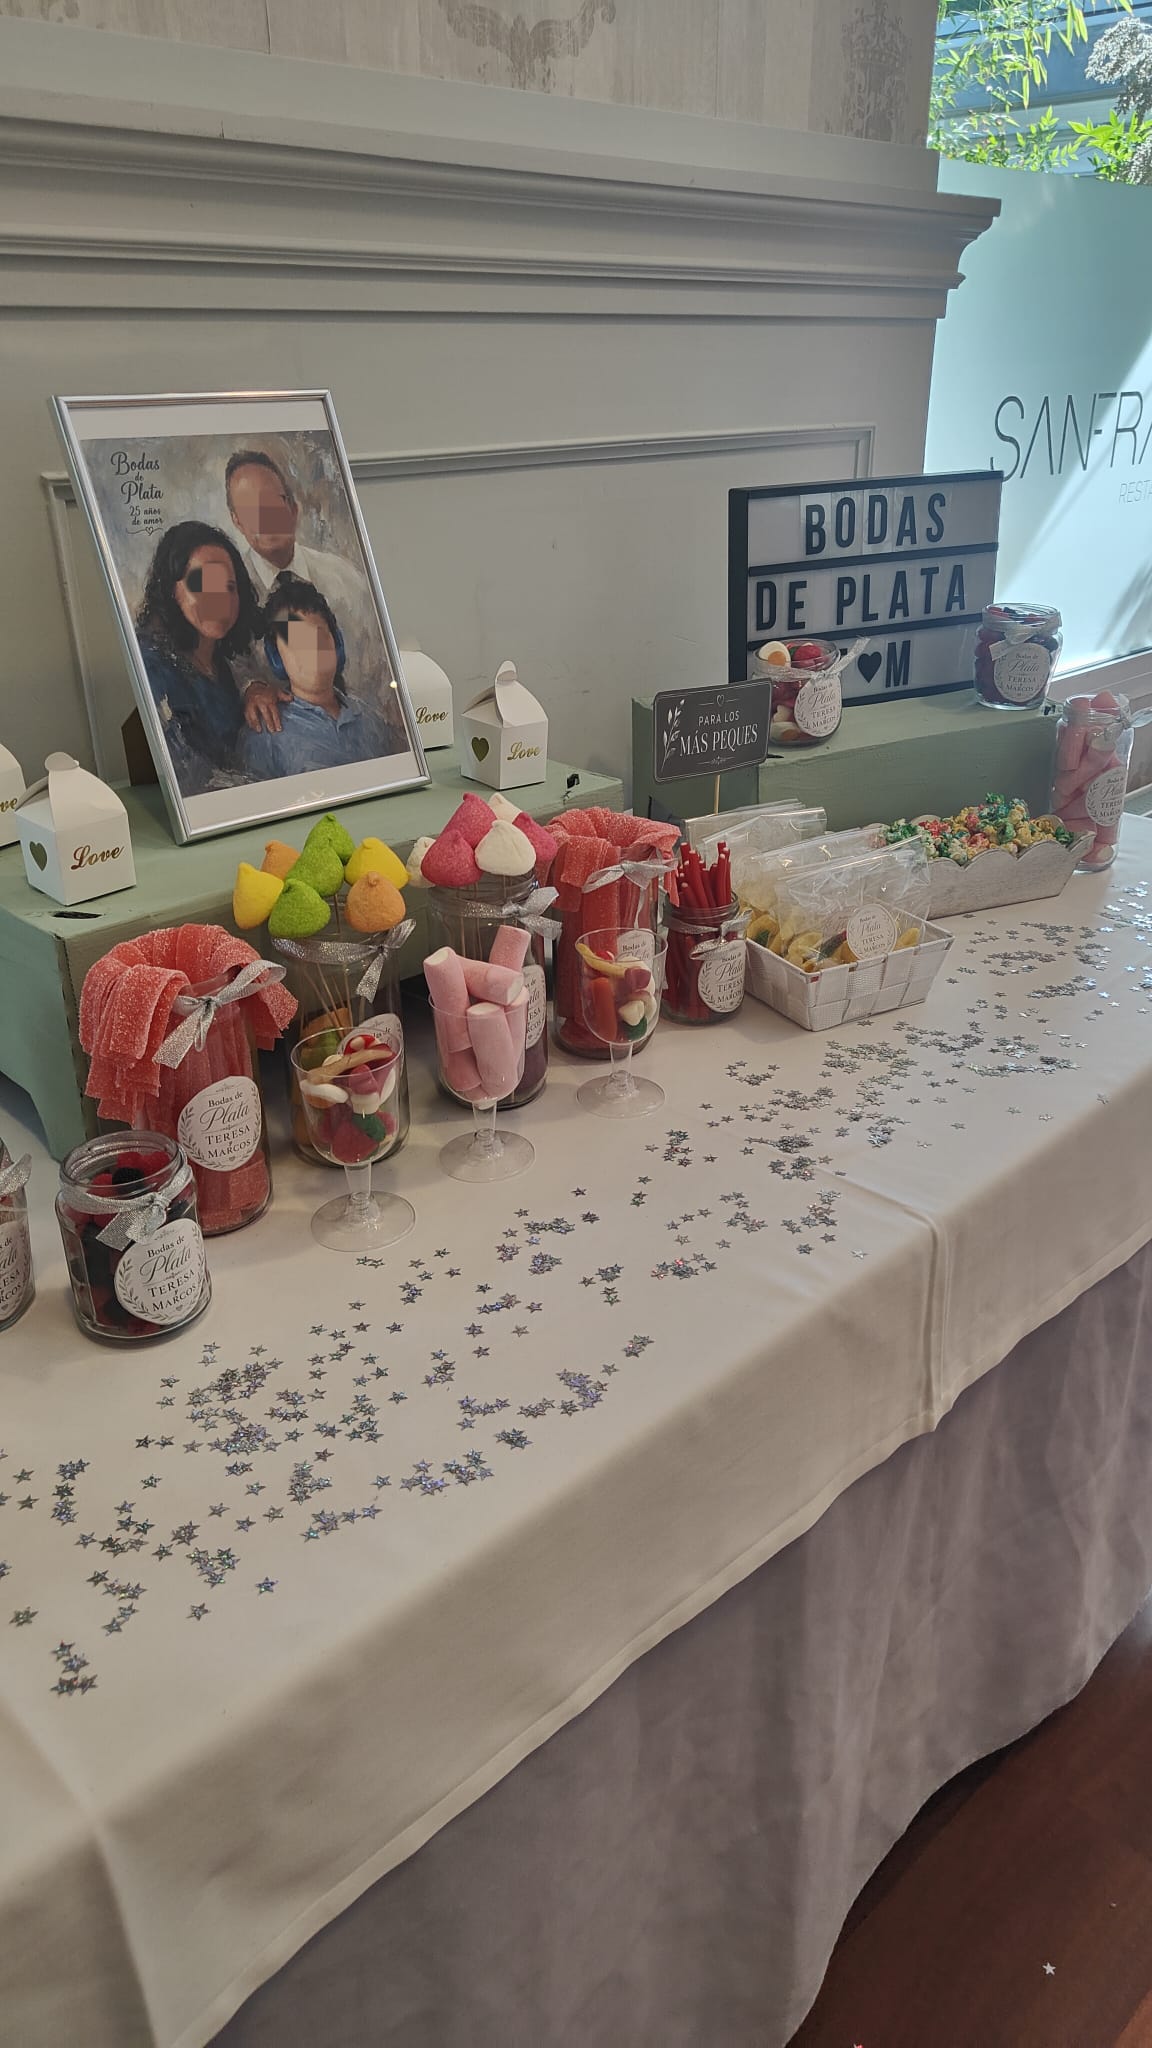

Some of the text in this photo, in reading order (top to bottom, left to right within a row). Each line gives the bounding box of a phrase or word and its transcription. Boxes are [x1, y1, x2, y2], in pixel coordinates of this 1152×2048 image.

[110, 451, 160, 475] Bodas
[134, 471, 144, 481] de
[120, 481, 163, 504] Plata
[129, 505, 161, 517] 25 años
[132, 516, 163, 526] de amor
[805, 493, 946, 556] BODAS
[756, 564, 965, 631] DE PLATA
[1008, 660, 1040, 673] Plata
[1006, 683, 1034, 692] MARCOS
[1008, 675, 1036, 683] TERESA
[807, 689, 836, 709] Plata
[415, 706, 449, 724] Love
[698, 710, 740, 727] PARA LOS
[811, 705, 836, 719] TERESA
[812, 715, 836, 729] MARCOS
[680, 723, 758, 757] MÁS PEQUES
[506, 741, 541, 761] Love
[70, 844, 125, 870] Love
[622, 943, 640, 952] Bodas
[862, 935, 884, 944] TERESA
[714, 960, 744, 981] Plata
[717, 979, 743, 993] TERESA
[208, 1090, 243, 1108] Bodas de
[200, 1101, 249, 1132] Plata
[205, 1125, 250, 1145] TERESA
[207, 1139, 251, 1159] MARCOS
[147, 1236, 184, 1258] Bodas de
[140, 1245, 191, 1285] Plata
[147, 1269, 195, 1298] TERESA
[152, 1285, 197, 1312] MARCOS
